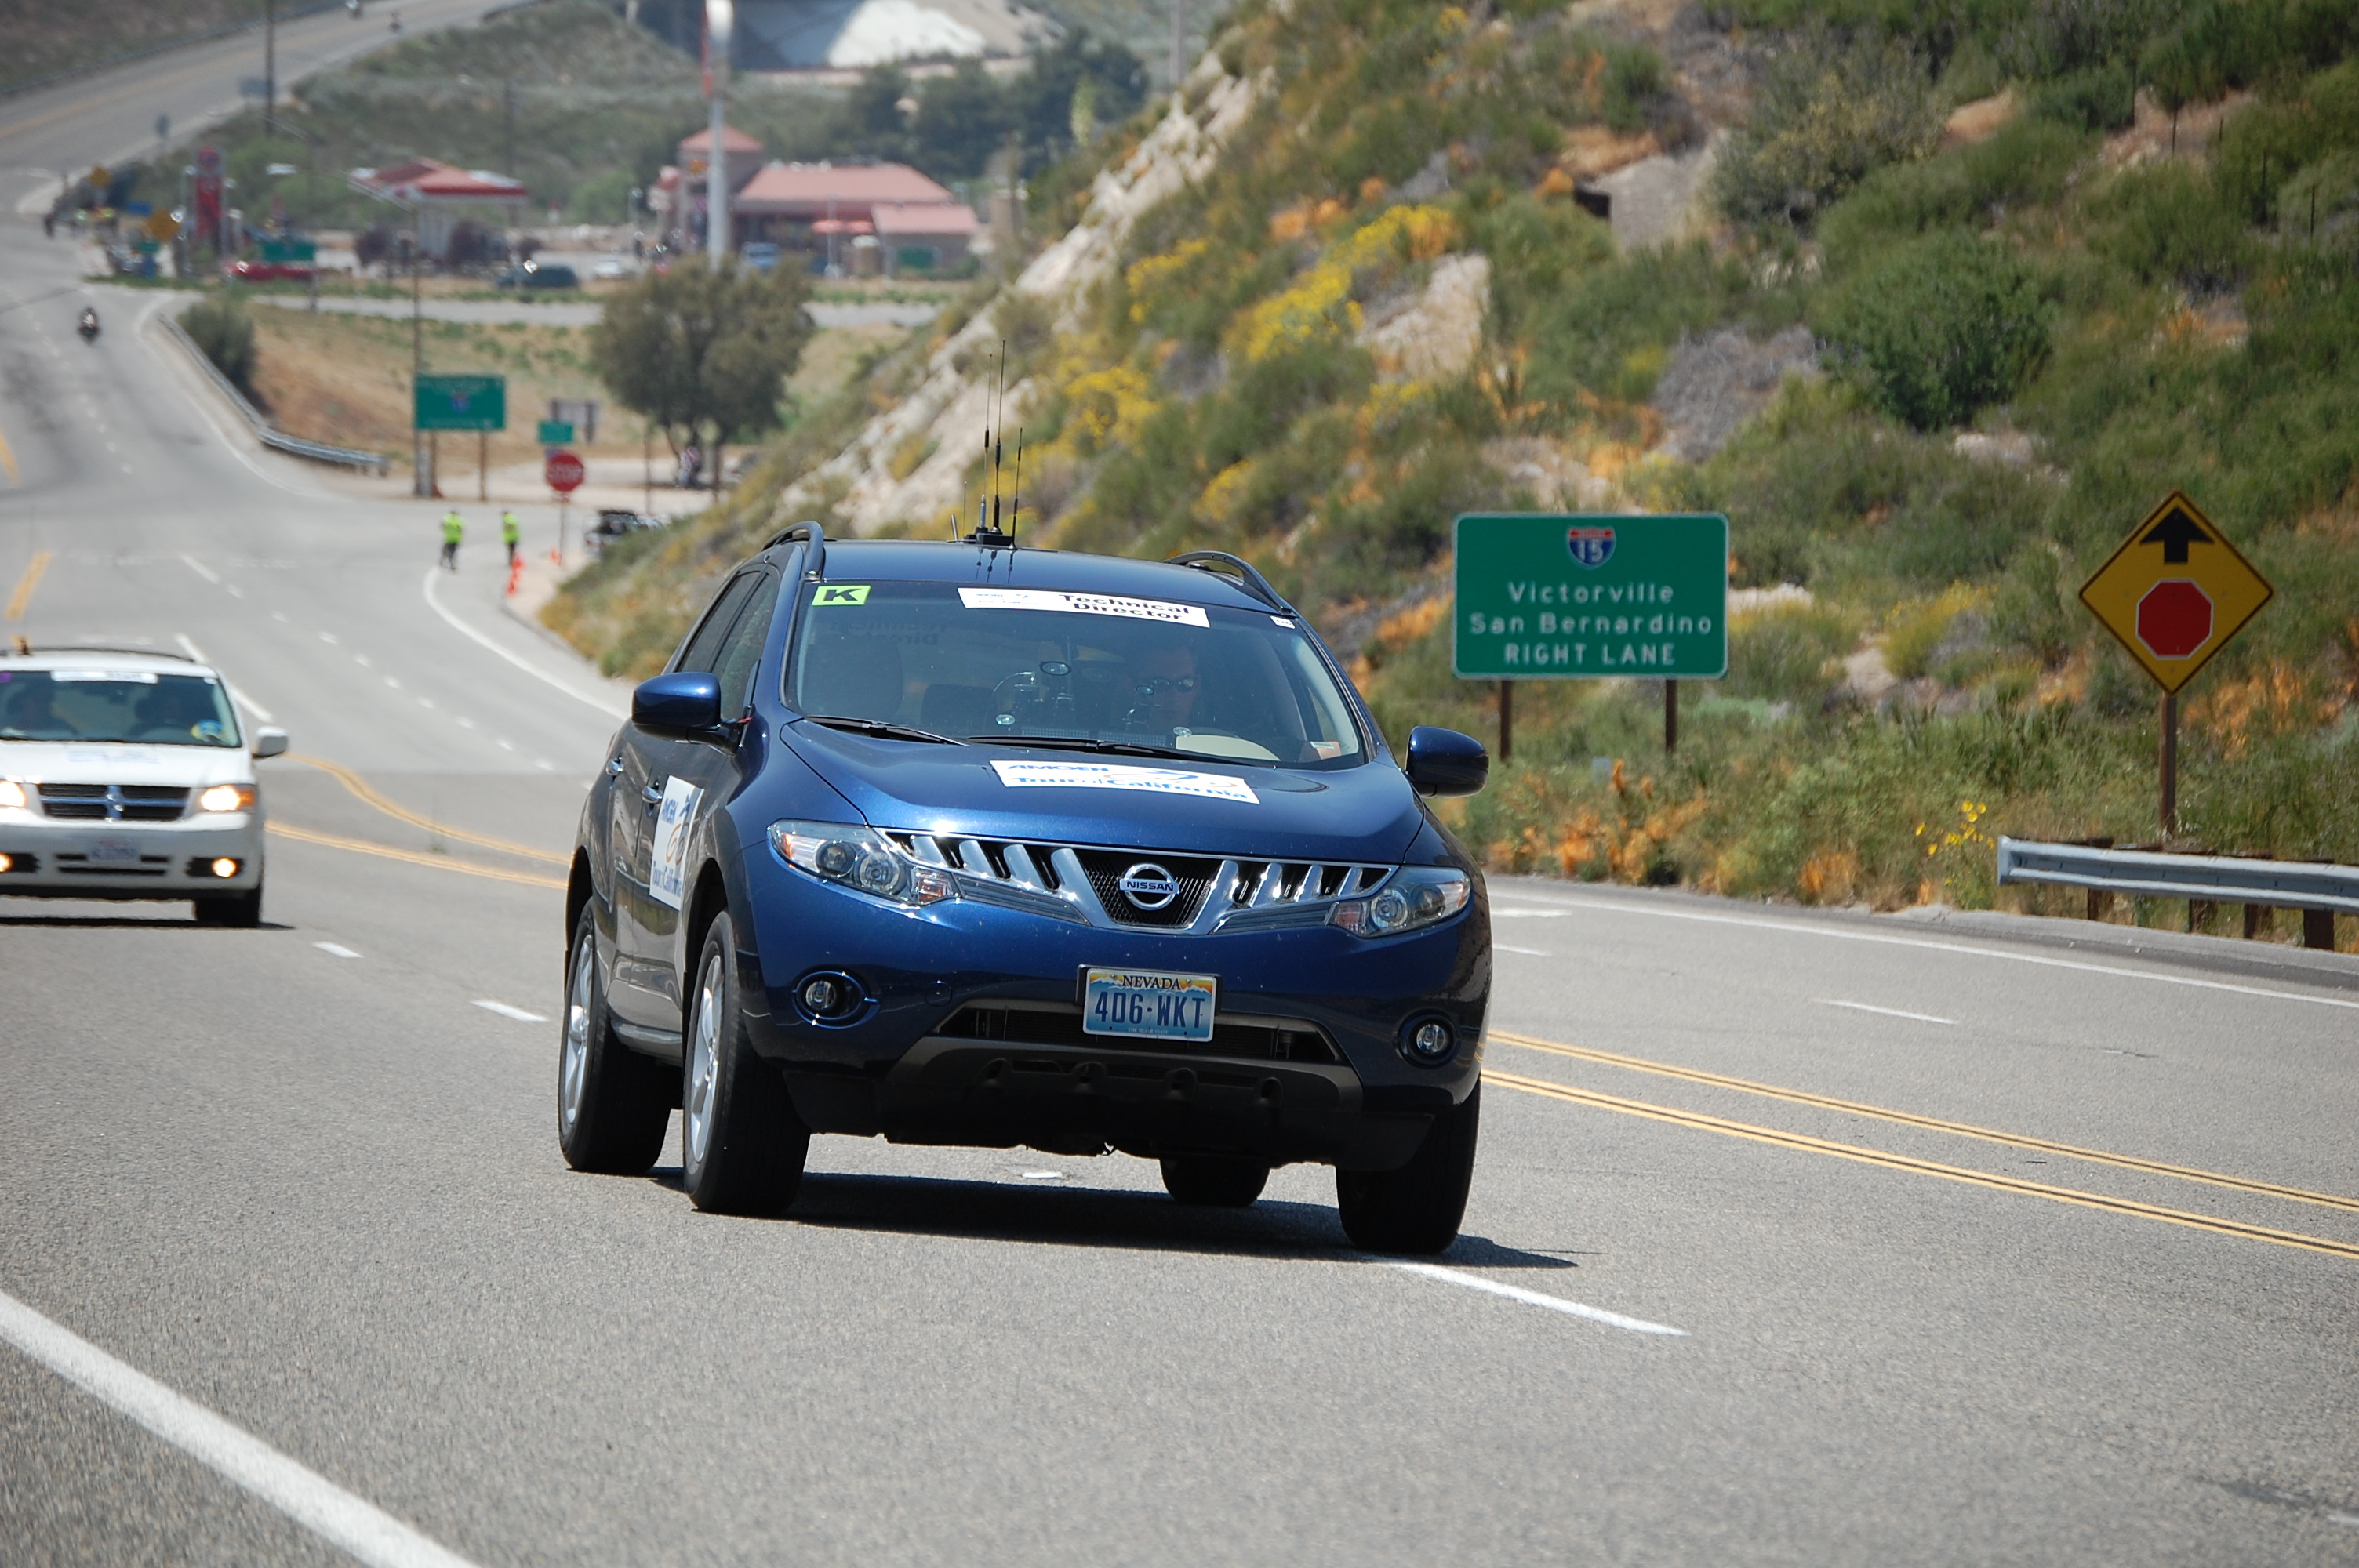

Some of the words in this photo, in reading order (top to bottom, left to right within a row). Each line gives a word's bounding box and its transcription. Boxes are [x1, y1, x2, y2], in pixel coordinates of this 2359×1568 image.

[1578, 539, 1605, 562] 15
[823, 589, 862, 601] K
[1507, 582, 1674, 604] Victorville
[1059, 594, 1190, 614] Technical
[1074, 603, 1182, 621] Director
[1470, 612, 1525, 635] San
[1539, 612, 1712, 635] Bernardino
[1504, 643, 1587, 665] RIGHT
[1603, 643, 1675, 665] LANE
[1106, 779, 1249, 799] California
[1126, 881, 1174, 891] NISSAN
[1121, 975, 1182, 990] NEVADA
